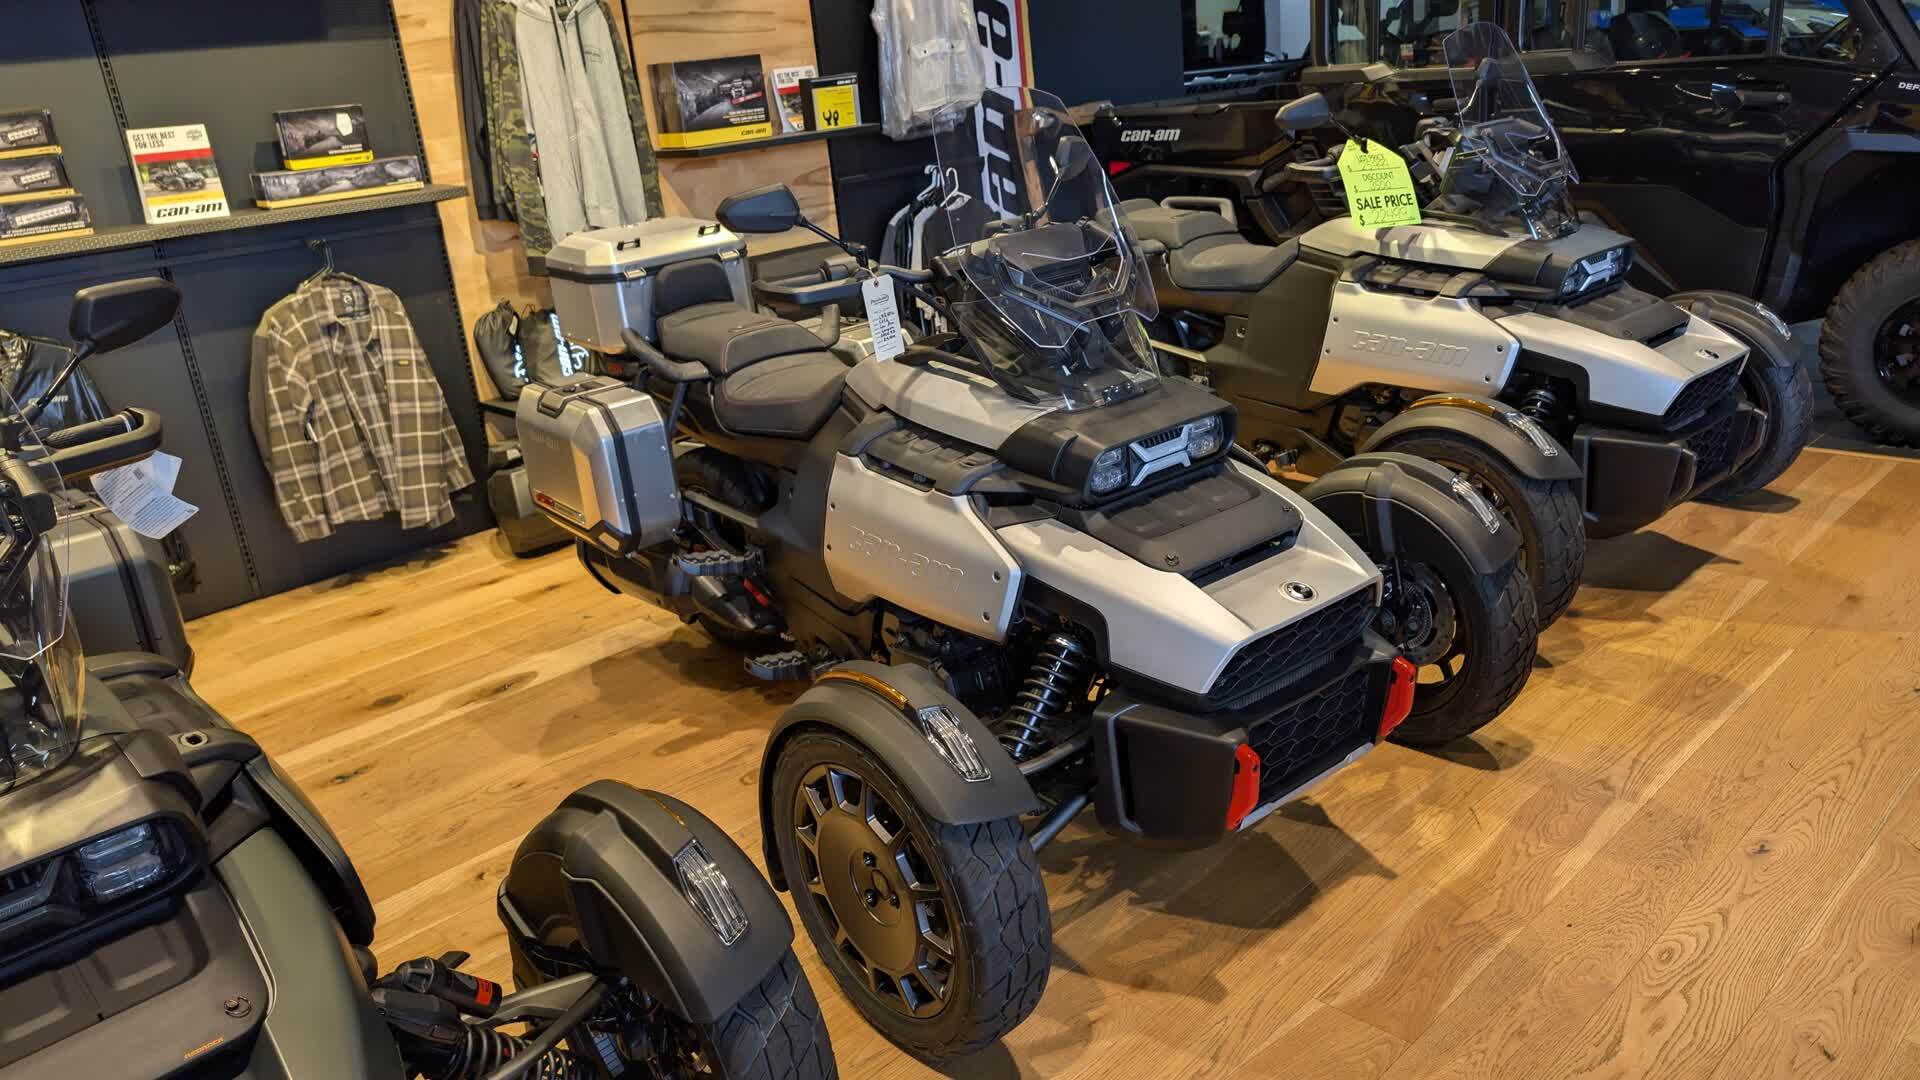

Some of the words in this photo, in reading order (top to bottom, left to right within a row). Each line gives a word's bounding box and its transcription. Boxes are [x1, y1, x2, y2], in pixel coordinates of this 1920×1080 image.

[1898, 82, 1920, 91] DEF
[132, 134, 145, 142] GET
[146, 132, 158, 141] THE
[159, 131, 175, 139] BEST
[1120, 128, 1181, 142] can-am
[134, 142, 148, 150] FOR
[149, 140, 165, 148] LESS
[1361, 171, 1394, 182] DISCOUNT
[1356, 196, 1383, 211] SALE
[1384, 193, 1414, 208] PRICE
[156, 202, 223, 218] can-am
[1359, 214, 1366, 227] $
